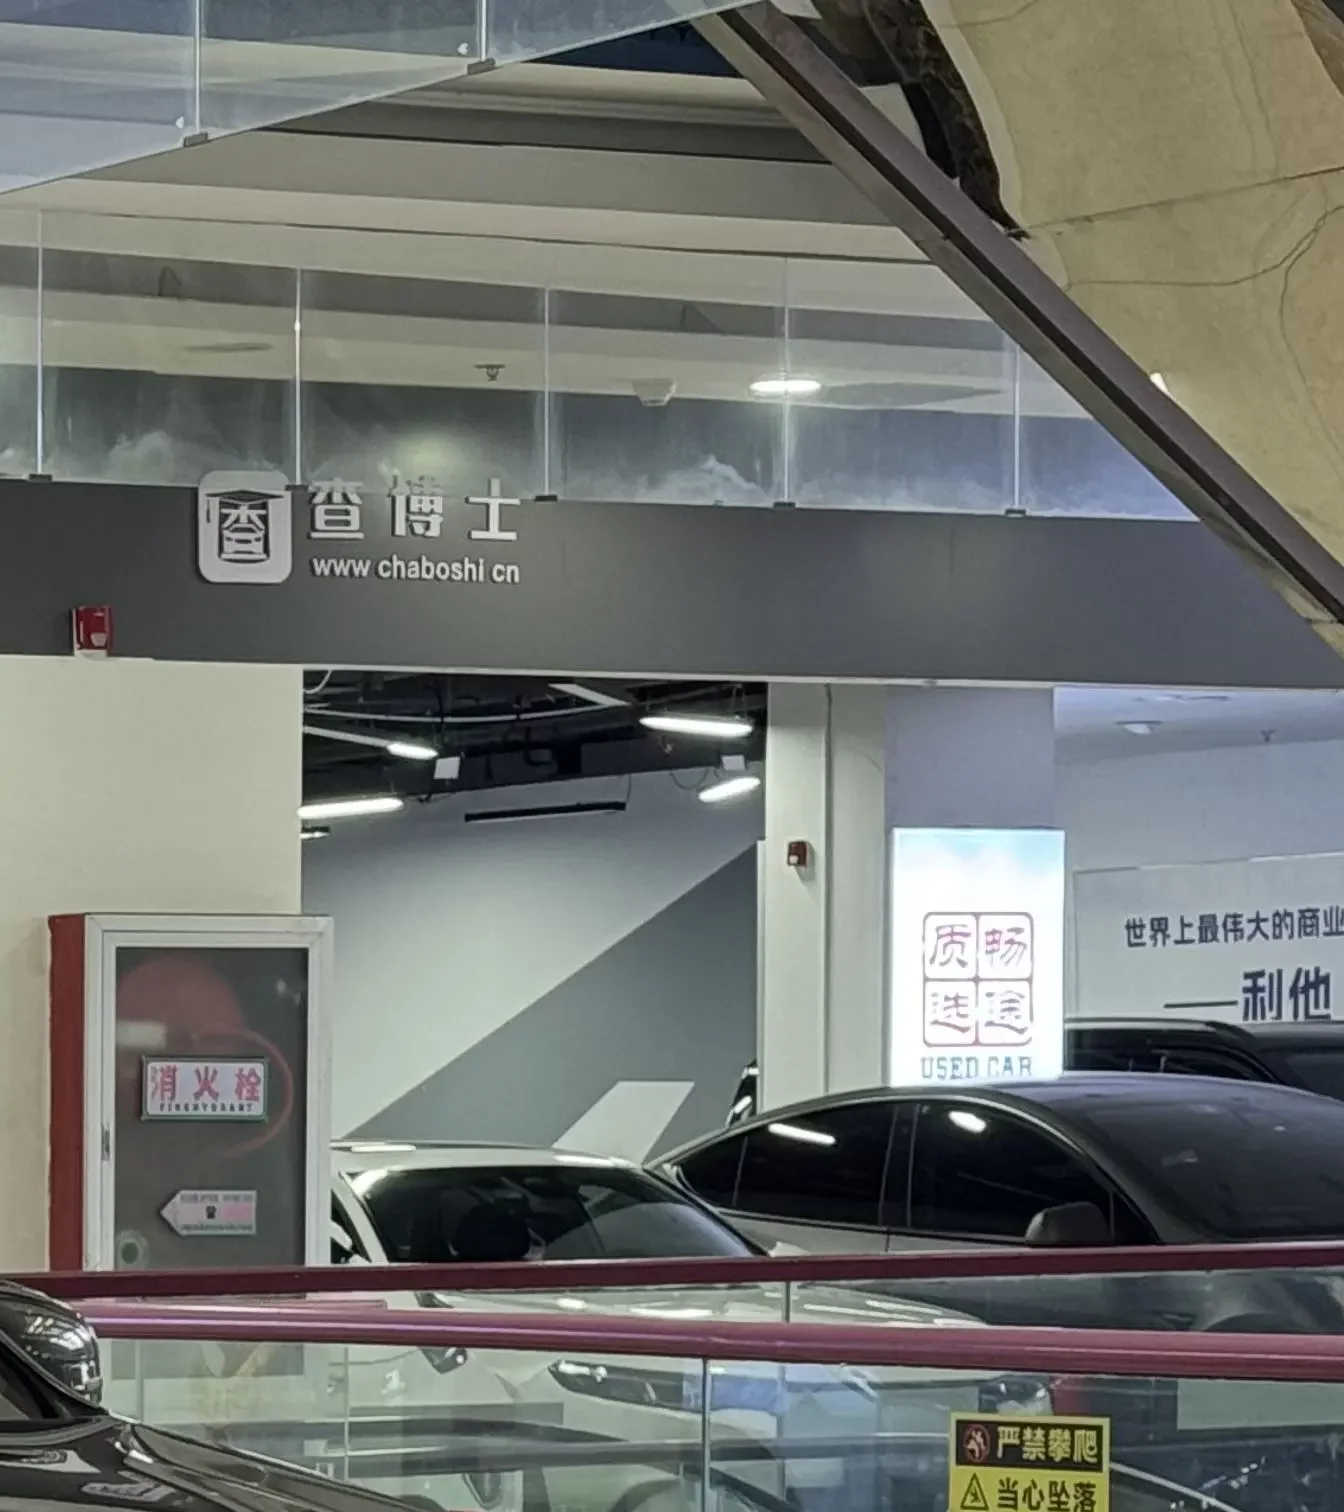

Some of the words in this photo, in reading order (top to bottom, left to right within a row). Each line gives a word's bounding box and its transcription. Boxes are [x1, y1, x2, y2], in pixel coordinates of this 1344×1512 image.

[307, 476, 521, 540] 查博士
[150, 1065, 261, 1103] 消火栓
[920, 1056, 979, 1081] USED
[987, 1056, 1033, 1079] CAR
[996, 1425, 1098, 1464] 严禁攀爬
